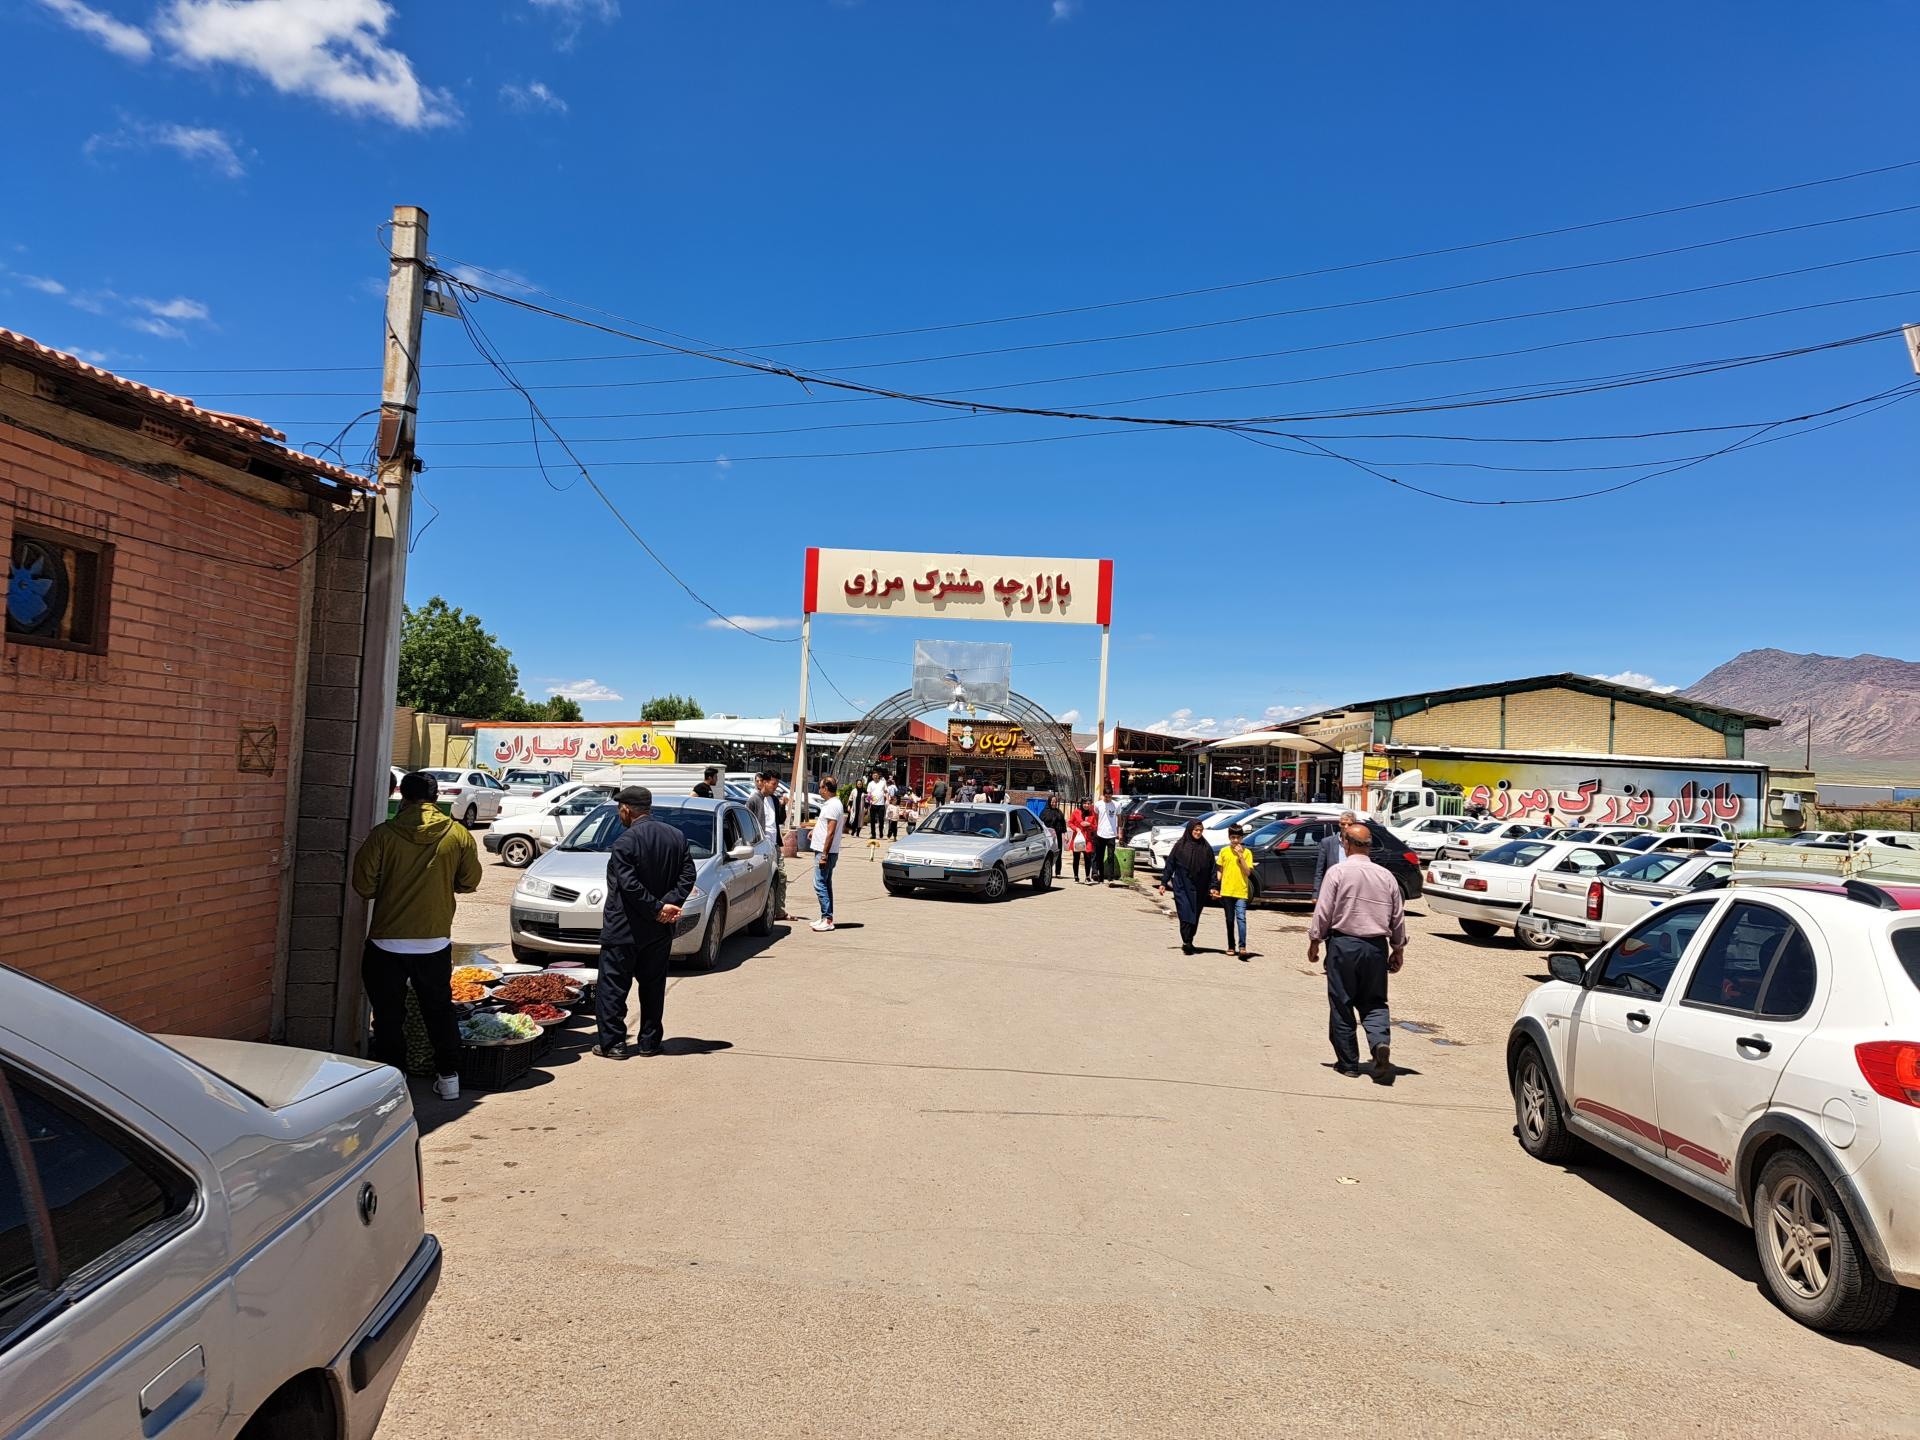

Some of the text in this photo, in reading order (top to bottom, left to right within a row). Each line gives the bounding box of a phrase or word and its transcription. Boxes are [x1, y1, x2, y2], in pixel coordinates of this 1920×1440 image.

[843, 568, 1071, 606] بازارچه مشترک مرزی
[495, 733, 659, 763] مقدمتان گلباران
[1470, 778, 1741, 833] بازار بزرگ مرزی
